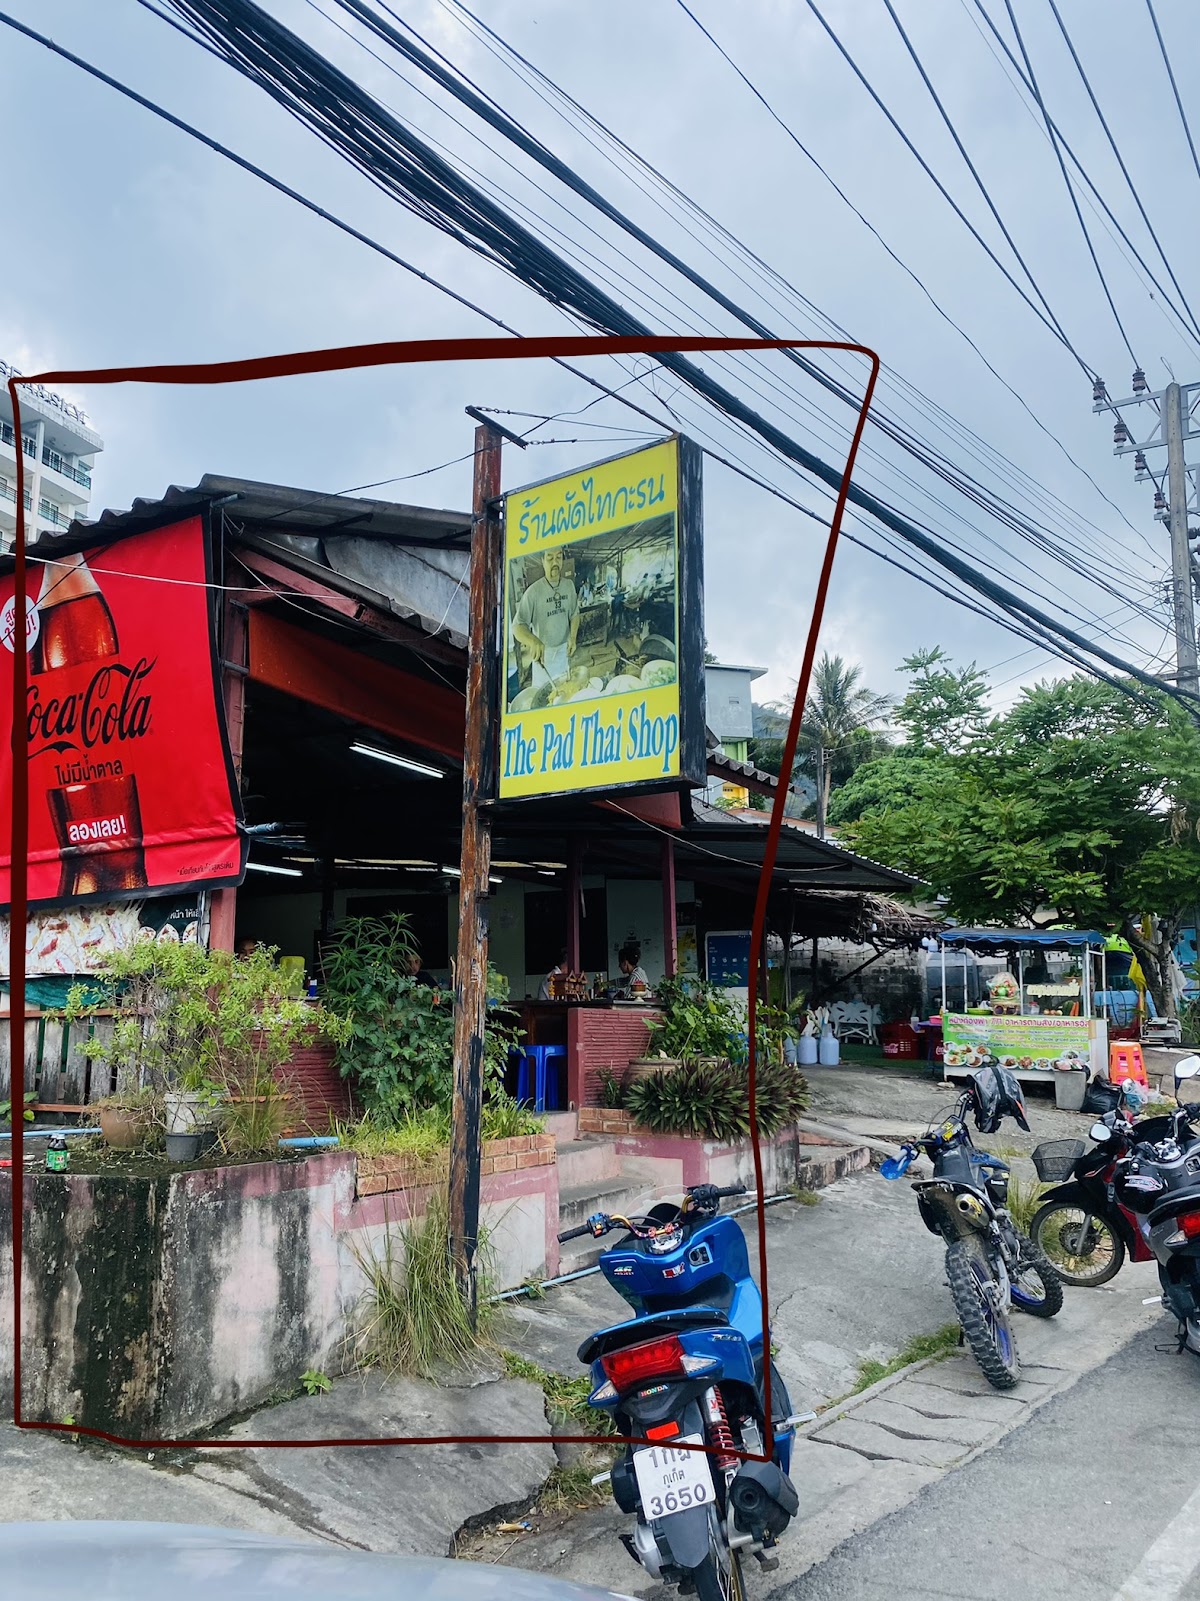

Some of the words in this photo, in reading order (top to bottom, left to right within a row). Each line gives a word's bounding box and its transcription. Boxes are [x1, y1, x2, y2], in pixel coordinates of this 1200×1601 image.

[503, 722, 537, 778] The
[539, 713, 576, 773] Pad
[580, 707, 623, 767] Thai
[626, 700, 678, 773] Shop
[54, 753, 124, 786] ไม่มีน้ำตาล
[69, 814, 128, 842] ลองเลย!
[640, 1384, 669, 1398] HONDA
[662, 1467, 686, 1489] ภูเก็ต
[650, 1482, 707, 1517] 3650
